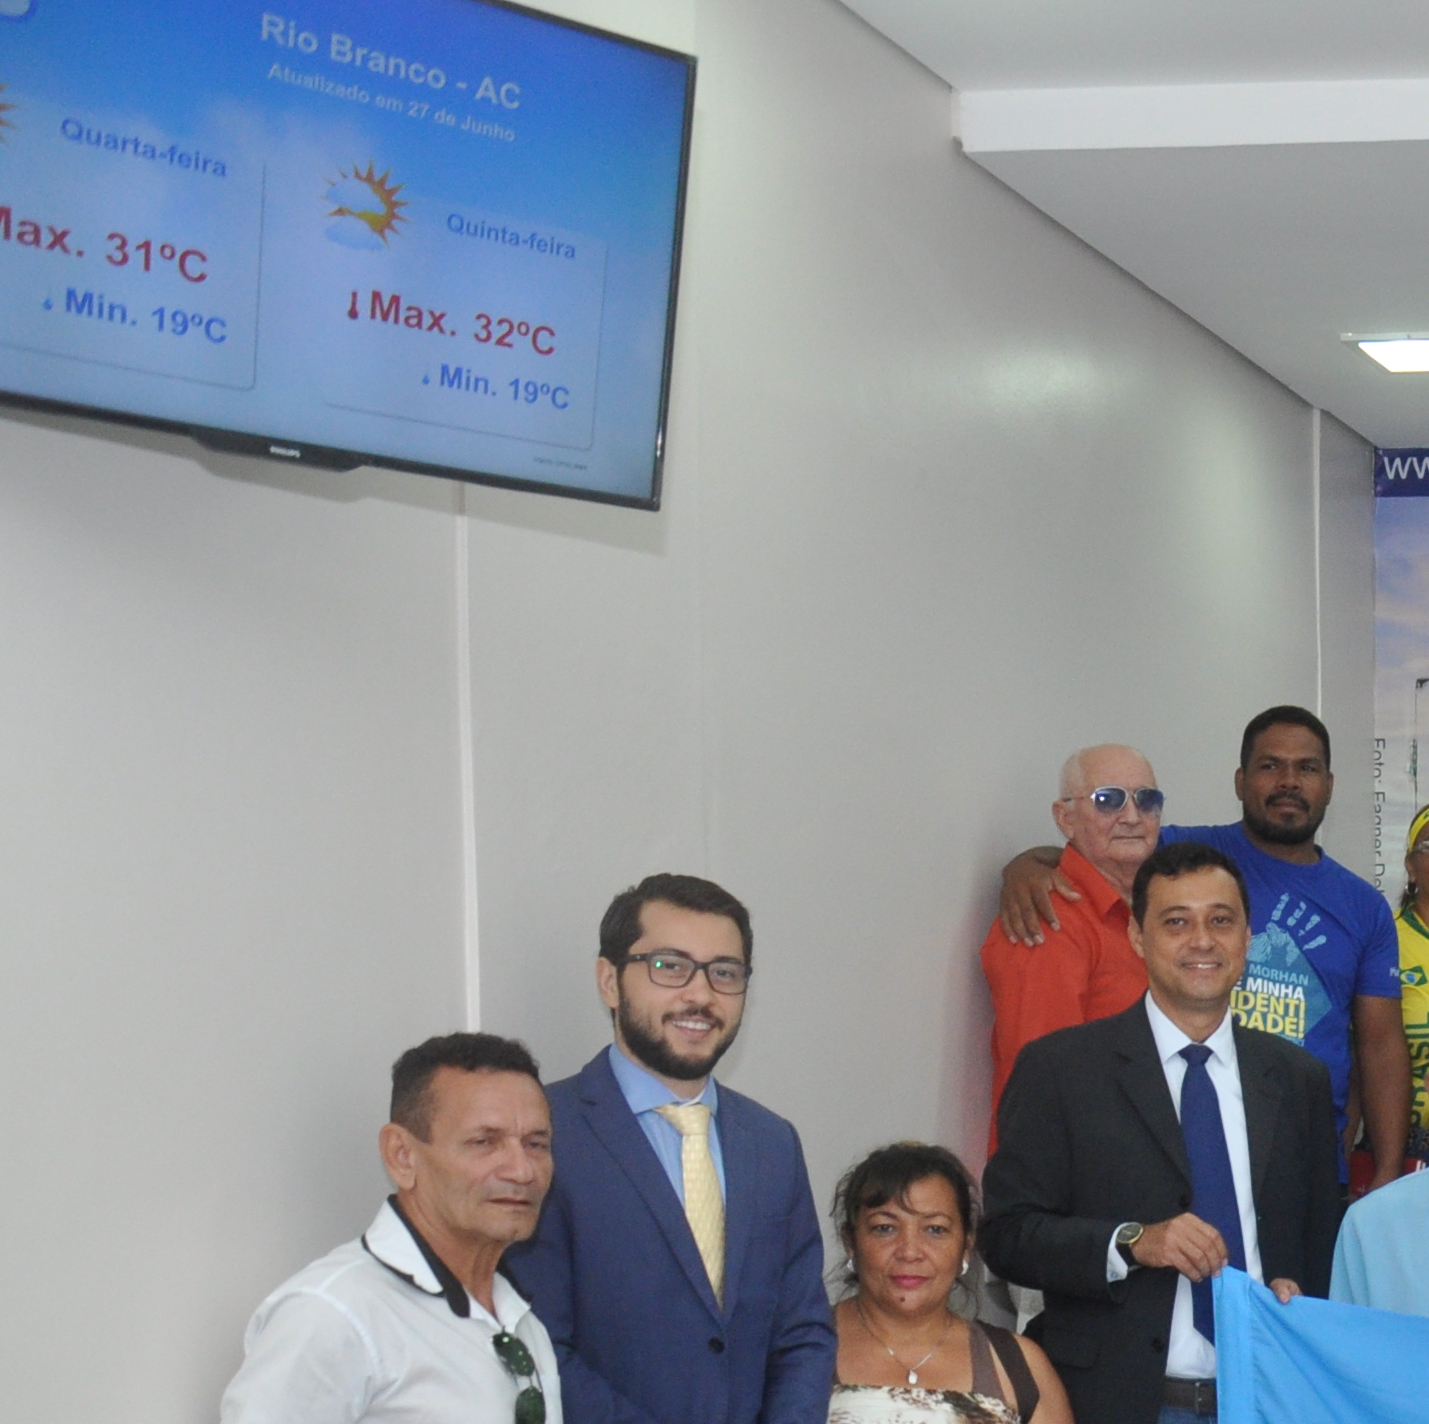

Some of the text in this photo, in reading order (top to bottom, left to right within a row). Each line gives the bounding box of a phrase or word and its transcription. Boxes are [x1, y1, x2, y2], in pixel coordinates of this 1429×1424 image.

[260, 12, 318, 54] Rio
[330, 33, 447, 90] Branco
[475, 76, 521, 110] AC
[267, 62, 515, 143] Atualizado em 27 de Junho
[60, 116, 227, 178] Quarta-feira
[446, 212, 577, 260] Quinta-feira
[65, 286, 138, 327] Min.
[369, 289, 457, 337] Max.
[439, 362, 497, 397] Min.
[1246, 976, 1305, 1000] MINHA
[1249, 962, 1309, 986] MORHAN
